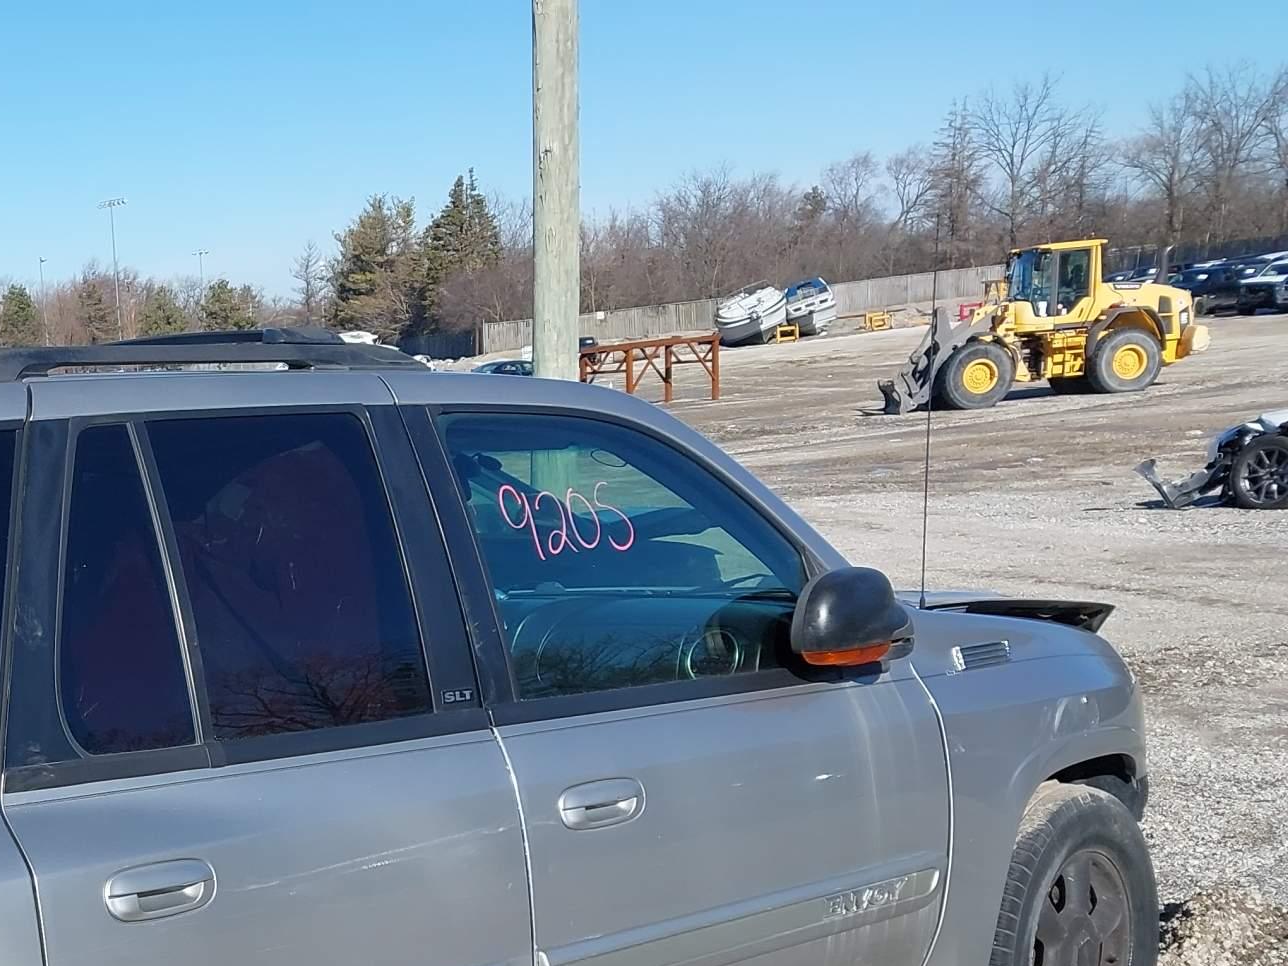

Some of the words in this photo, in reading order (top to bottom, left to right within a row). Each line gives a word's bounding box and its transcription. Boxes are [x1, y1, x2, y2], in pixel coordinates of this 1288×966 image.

[499, 481, 635, 561] 9205
[444, 690, 473, 703] SLT
[824, 878, 908, 917] ENVOY
